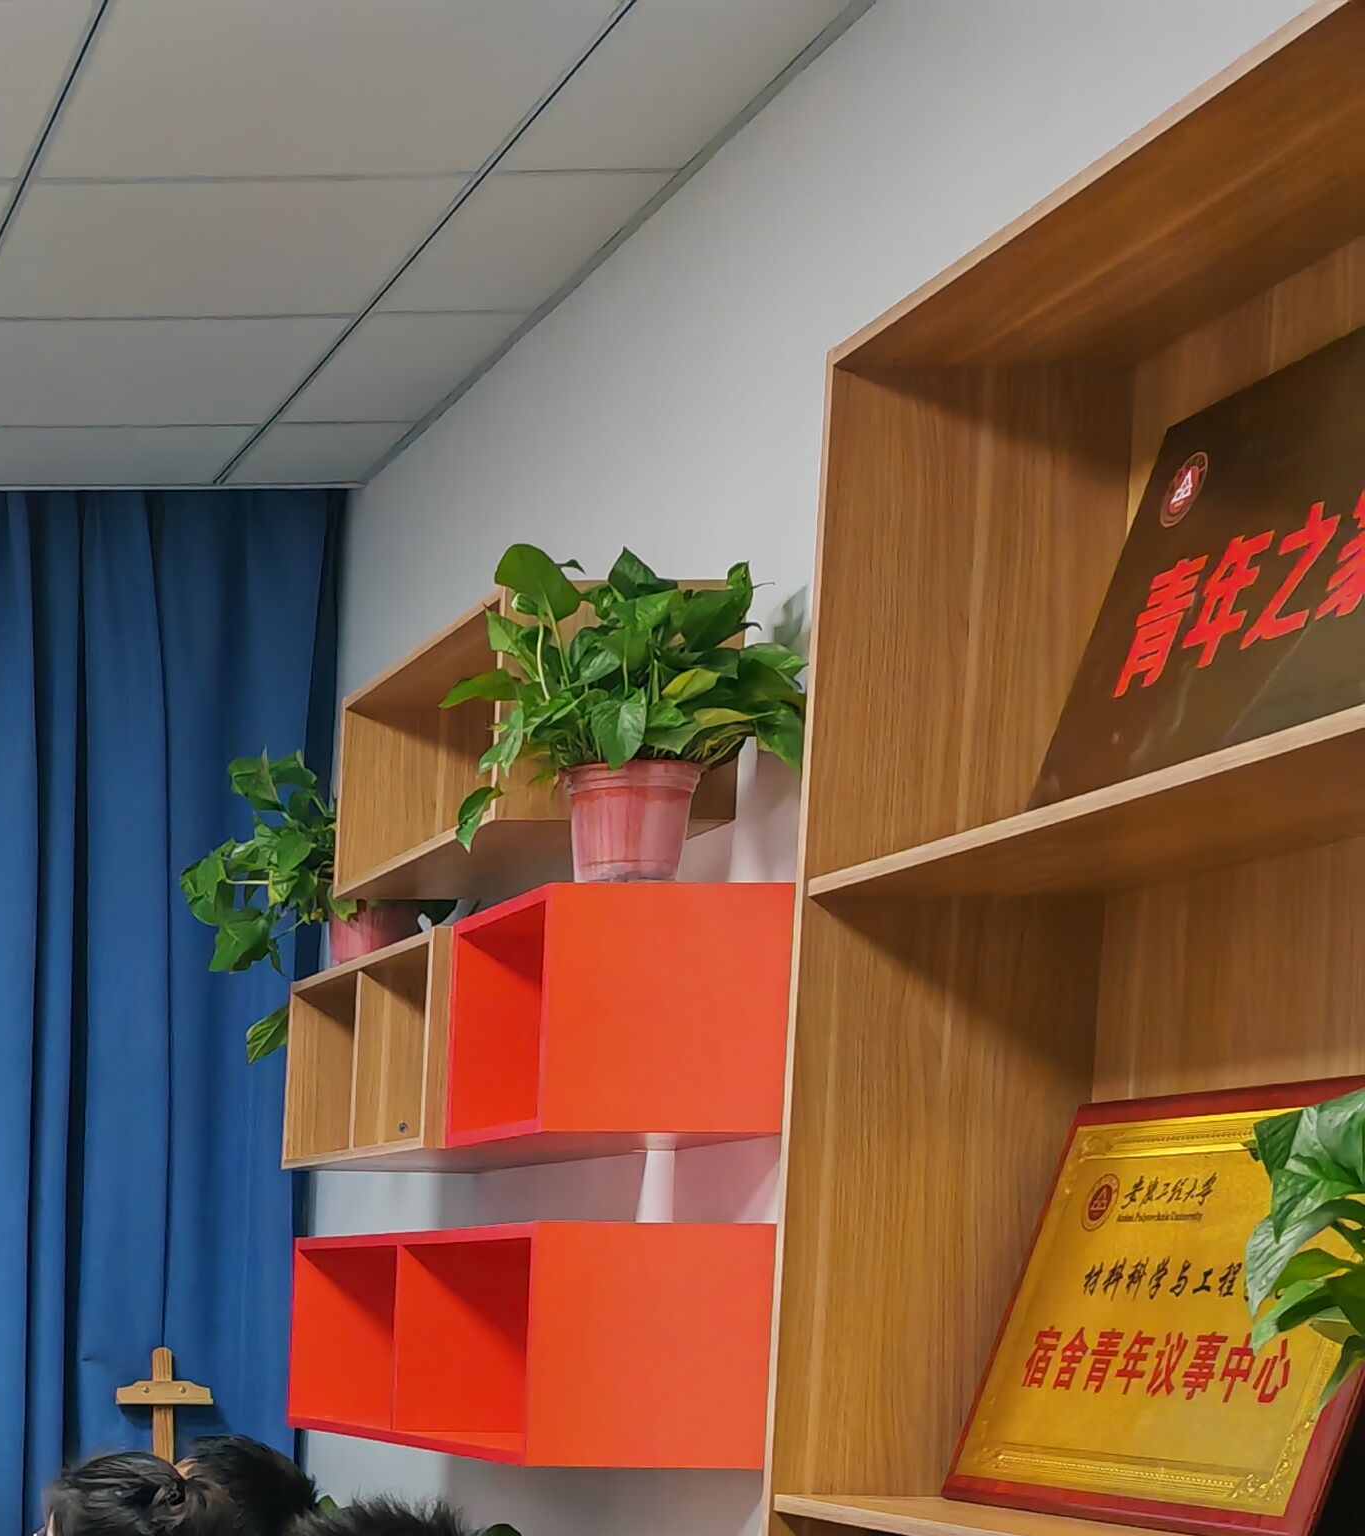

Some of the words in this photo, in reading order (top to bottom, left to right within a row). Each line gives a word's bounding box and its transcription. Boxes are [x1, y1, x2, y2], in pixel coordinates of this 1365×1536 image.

[1083, 1256, 1254, 1301] 材料科学与工程
[1021, 1326, 1291, 1405] 宿舍青年议事中心
